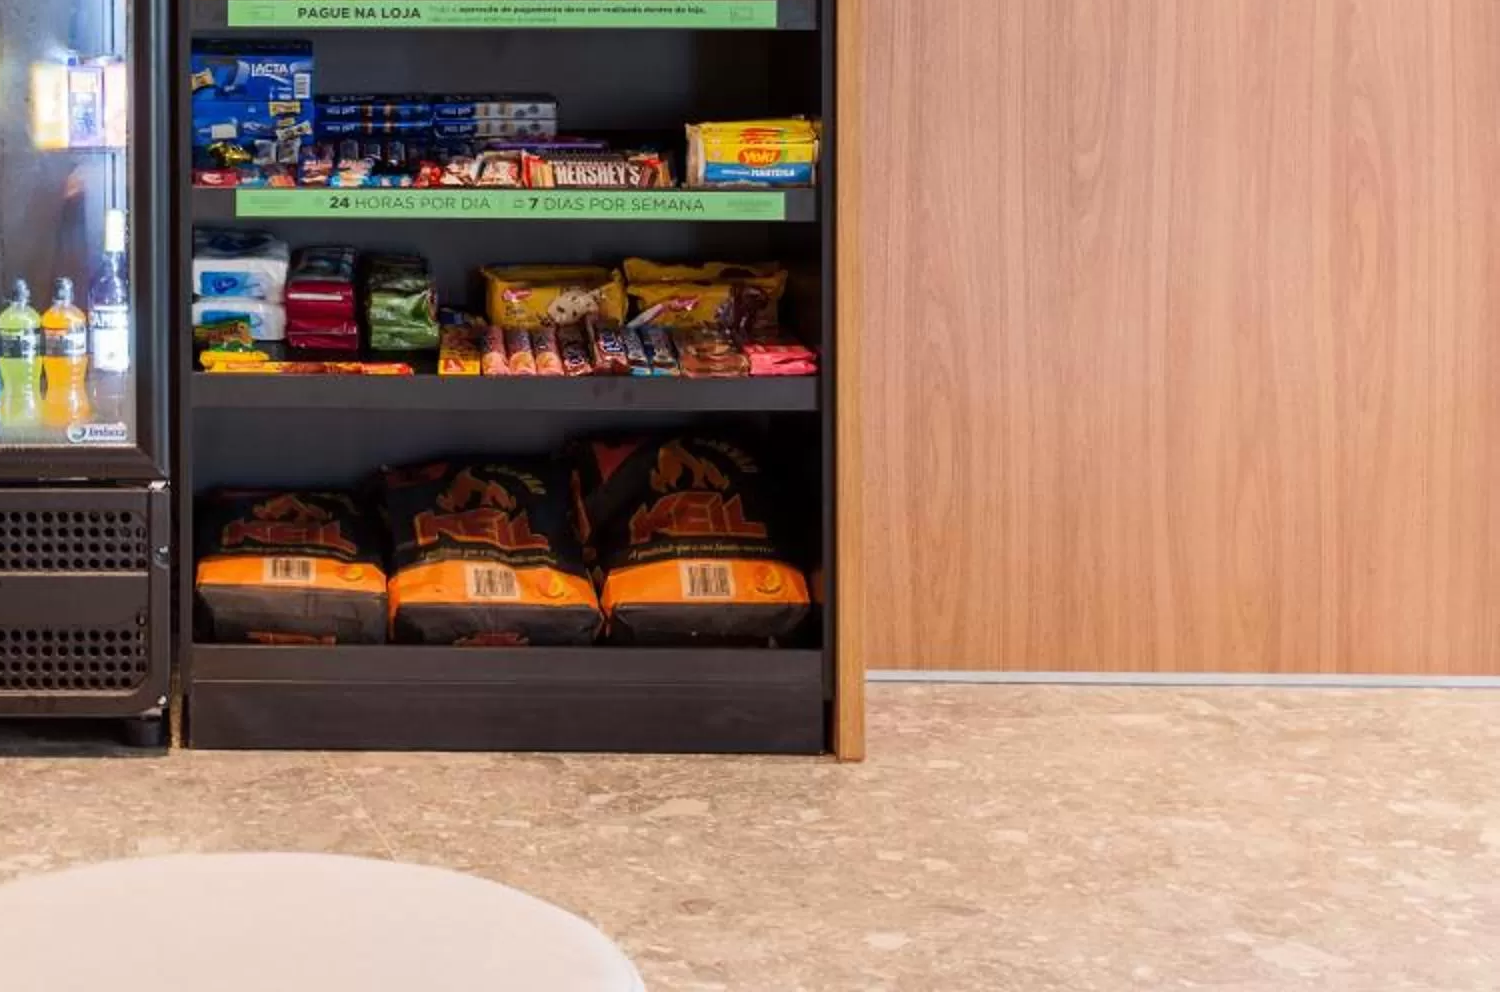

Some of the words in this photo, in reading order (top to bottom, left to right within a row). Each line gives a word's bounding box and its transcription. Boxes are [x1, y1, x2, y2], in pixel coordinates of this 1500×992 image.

[297, 7, 350, 19] PAGUE
[355, 7, 377, 19] NA
[381, 7, 421, 19] LOJA
[251, 63, 289, 77] LACTA
[555, 165, 640, 185] HERSHEY'S
[329, 196, 350, 209] 24
[354, 196, 415, 209] HORAS
[418, 197, 456, 209] POR
[461, 196, 491, 209] DIA
[528, 197, 539, 209] 7
[543, 198, 585, 211] DIAS
[589, 198, 626, 211] POR
[630, 198, 705, 212] SEMANA
